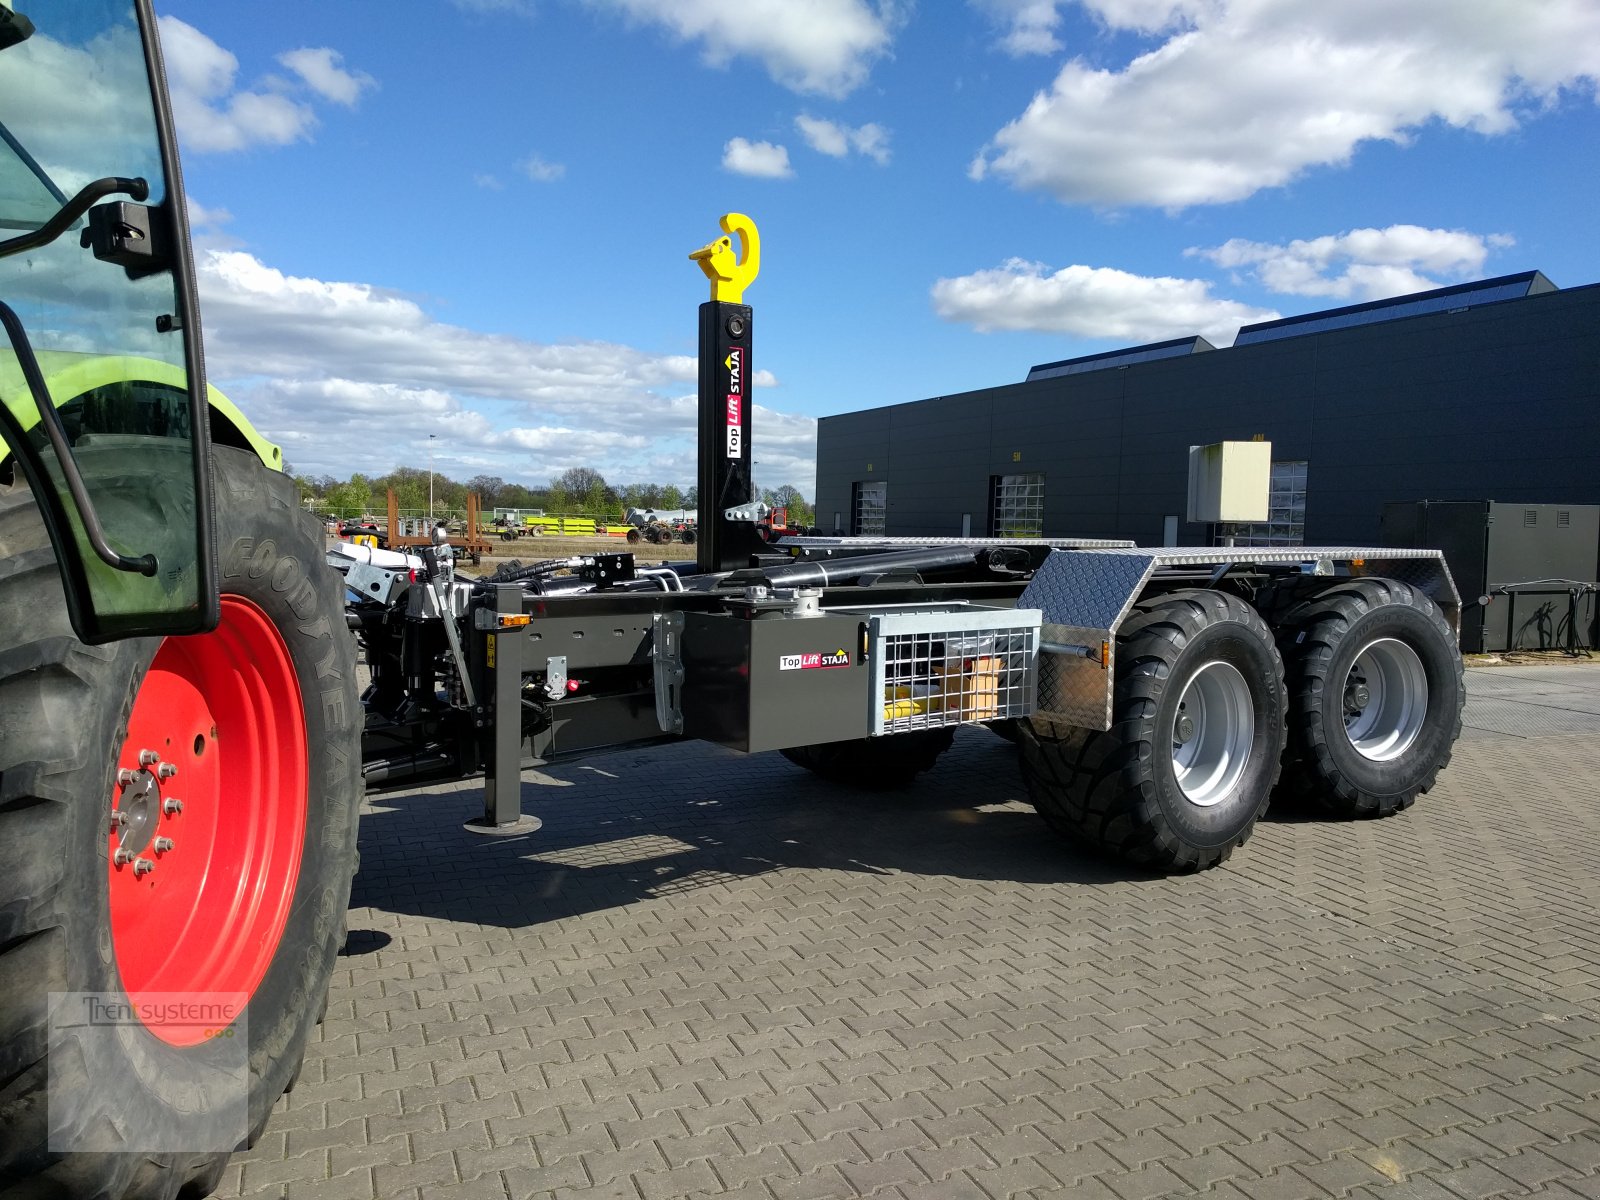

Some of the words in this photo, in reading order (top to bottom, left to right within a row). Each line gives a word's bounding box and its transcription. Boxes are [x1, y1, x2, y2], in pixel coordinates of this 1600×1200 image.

[730, 350, 740, 394] STAJA
[728, 397, 738, 424] Lift
[728, 428, 740, 455] Top
[782, 657, 800, 667] Top
[802, 655, 819, 665] Lift
[821, 654, 849, 665] STAJA
[224, 537, 350, 850] GOODYEAR
